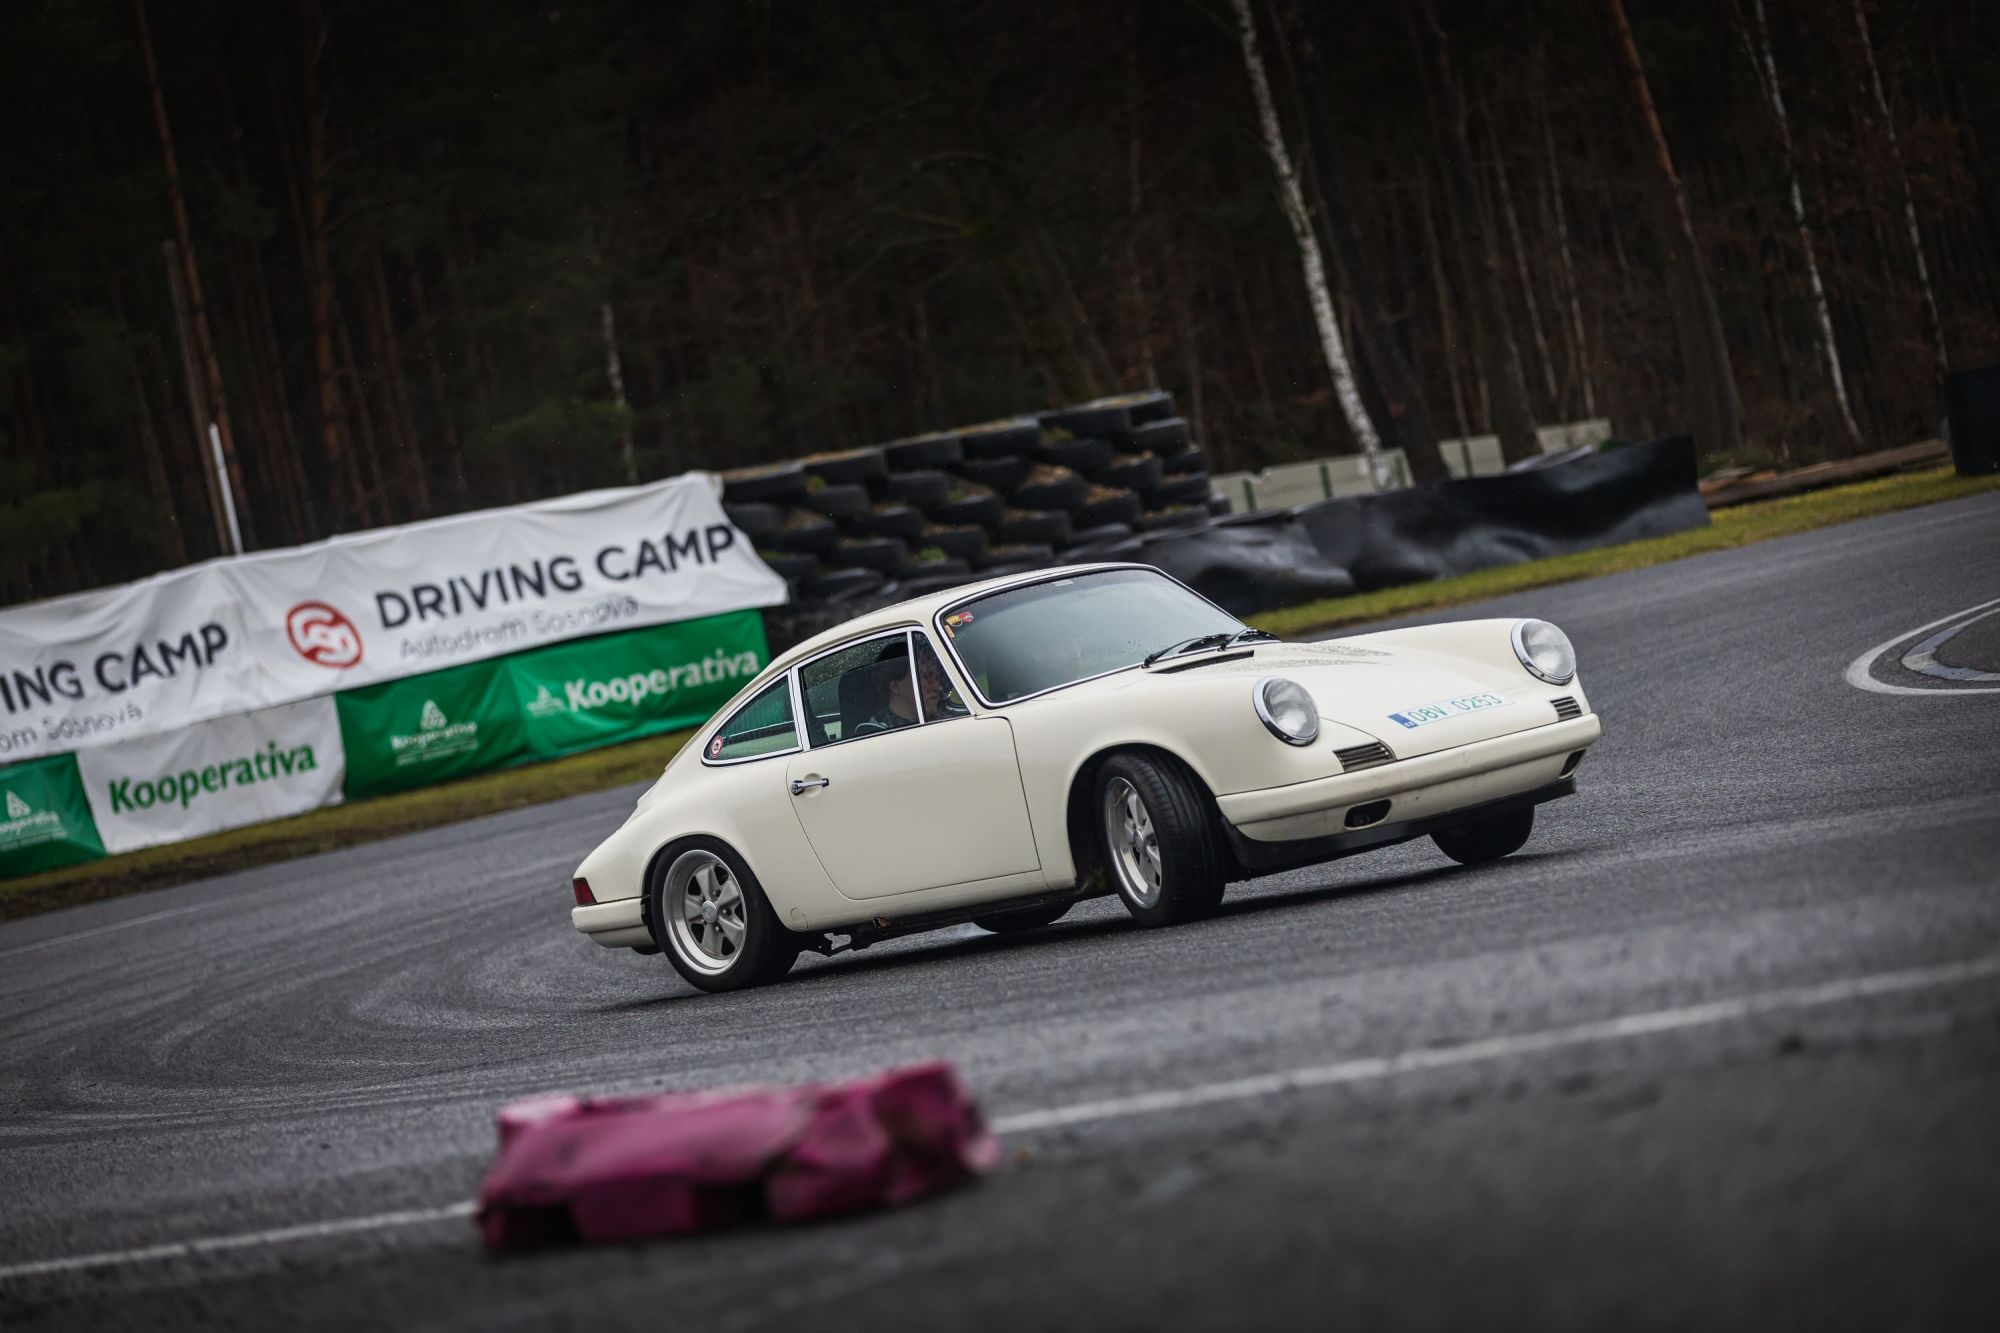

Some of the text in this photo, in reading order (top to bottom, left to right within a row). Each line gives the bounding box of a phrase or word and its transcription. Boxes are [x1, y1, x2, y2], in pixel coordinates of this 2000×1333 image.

[374, 523, 737, 630] DRIVING CAMP
[95, 623, 229, 693] CAMP
[564, 648, 761, 712] Kooperativa
[1451, 694, 1503, 711] 0253
[108, 741, 318, 814] Kooperativa
